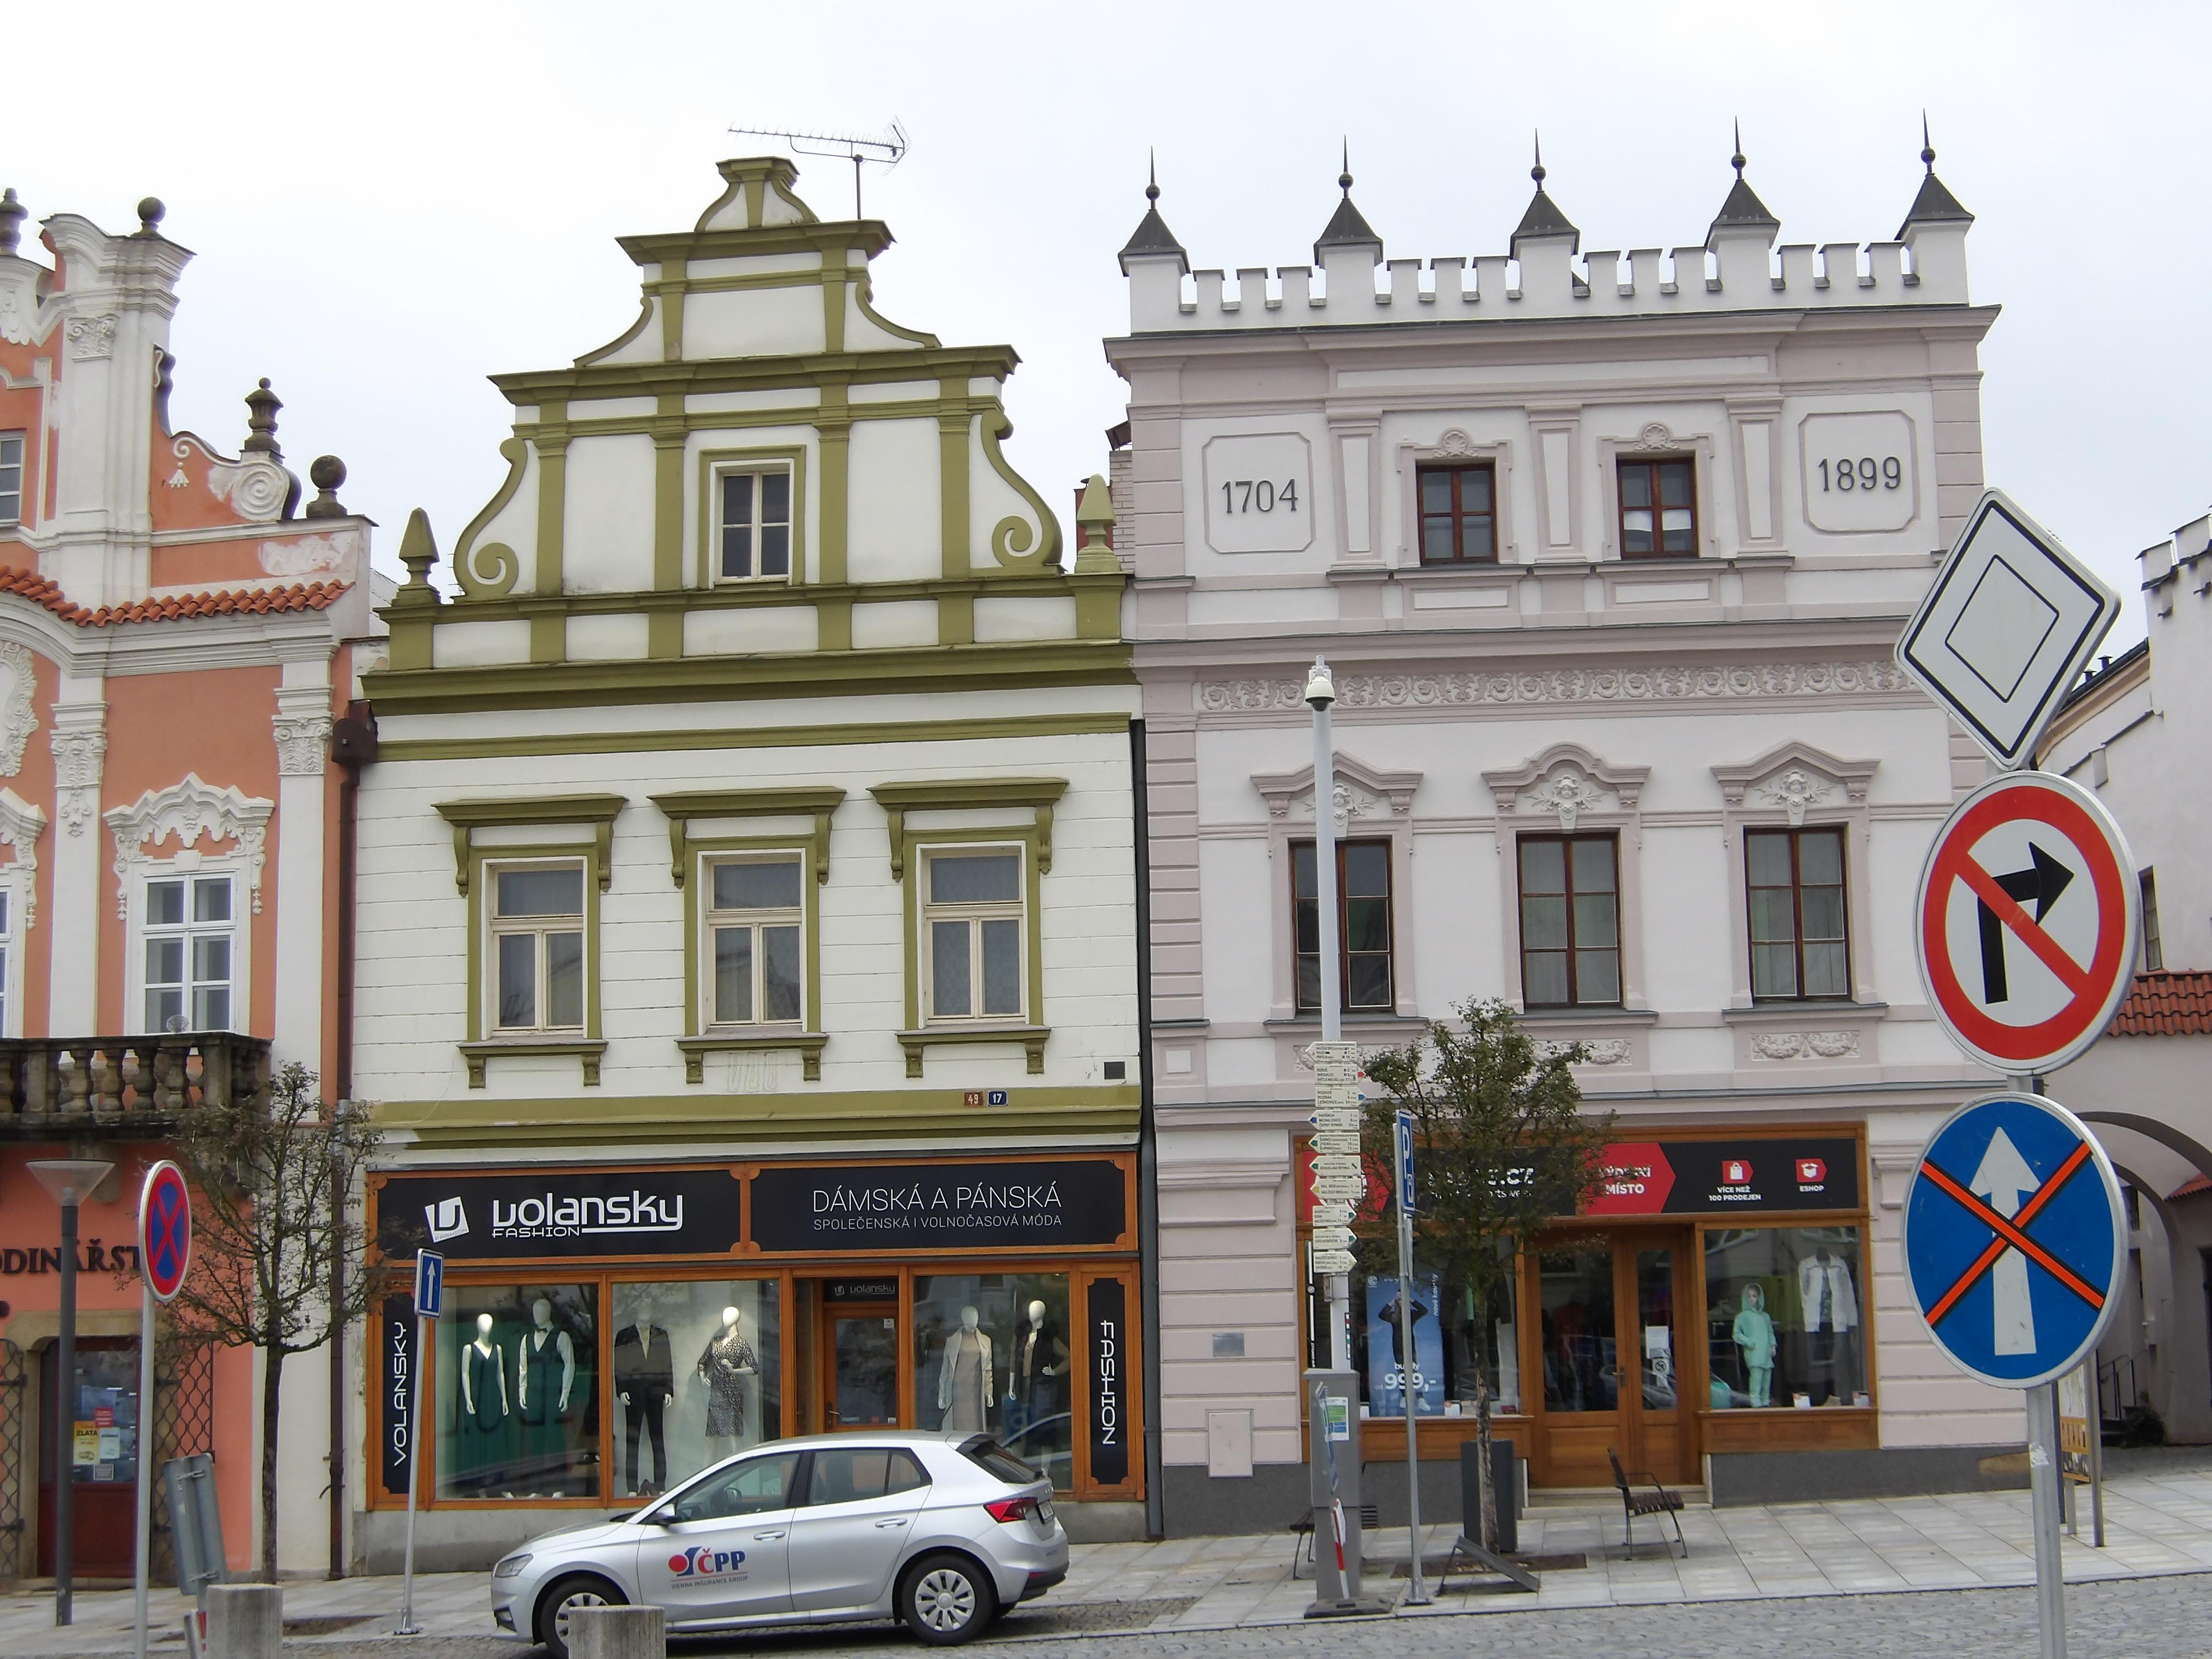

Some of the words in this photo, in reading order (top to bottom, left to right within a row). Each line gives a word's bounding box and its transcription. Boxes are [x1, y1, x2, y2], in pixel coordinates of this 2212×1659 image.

[1818, 456, 1901, 492] 1899
[1222, 478, 1298, 513] 1704
[968, 1094, 978, 1104] 49
[993, 1093, 1002, 1103] 17
[813, 1183, 924, 1212] DÁMSKÁ
[931, 1188, 948, 1209] A
[957, 1181, 1062, 1209] PÁNSKÁ
[1605, 1182, 1645, 1194] MÍSTO
[814, 1215, 910, 1230] SPOLEČENSKÁ
[914, 1217, 917, 1228] I
[921, 1213, 1019, 1228] VOLNOČASOVÁ
[1022, 1213, 1062, 1226] MÓDA
[492, 1227, 580, 1238] FASHION
[1100, 1319, 1116, 1445] FASHION
[394, 1322, 407, 1467] VOLANSKY
[698, 1548, 746, 1574] ČPP
[694, 1578, 727, 1587] INSURANCE
[728, 1574, 749, 1583] GROUP
